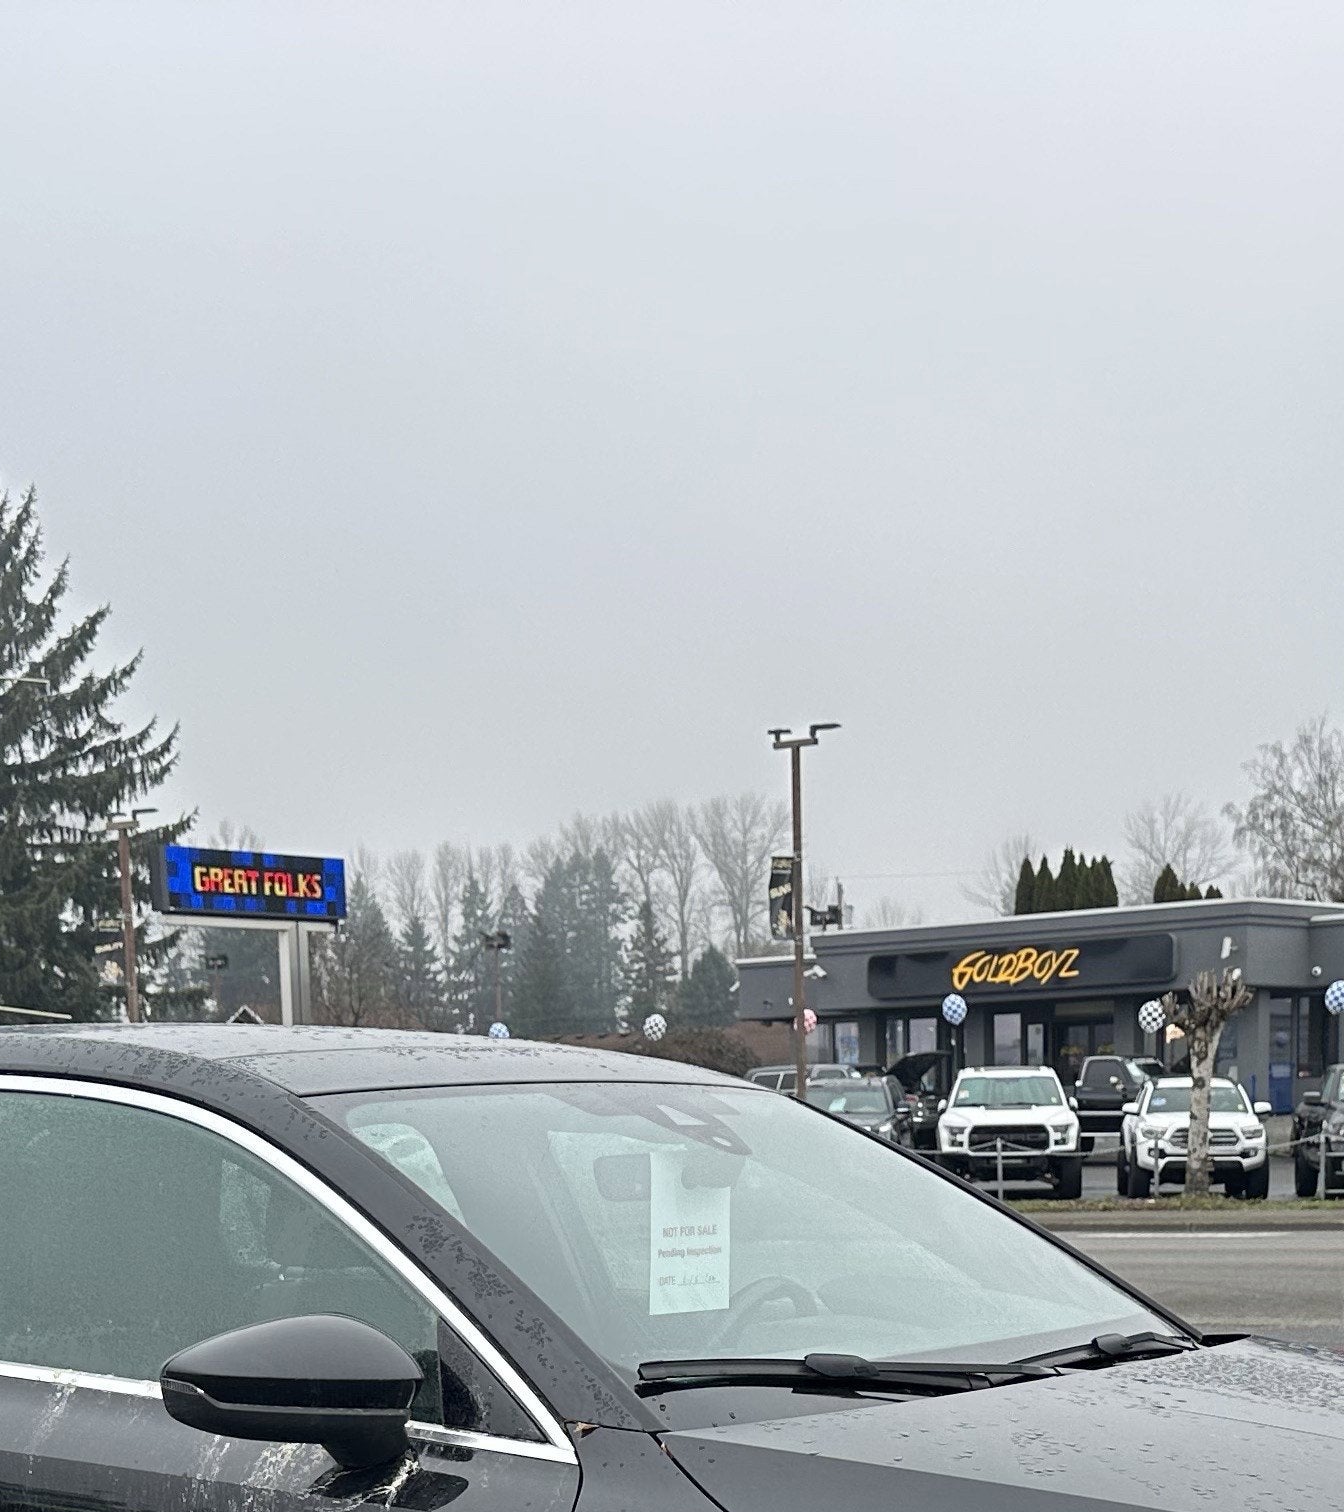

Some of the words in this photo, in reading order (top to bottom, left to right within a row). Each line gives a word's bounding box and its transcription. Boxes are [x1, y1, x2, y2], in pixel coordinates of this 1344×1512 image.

[194, 866, 258, 895] GREAT
[263, 870, 322, 899] FOLKS
[952, 947, 1080, 991] GOLDBOYZ
[662, 1226, 678, 1238] NOT
[679, 1225, 696, 1237] FOR
[697, 1224, 718, 1236] SALE
[659, 1275, 676, 1287] DATE
